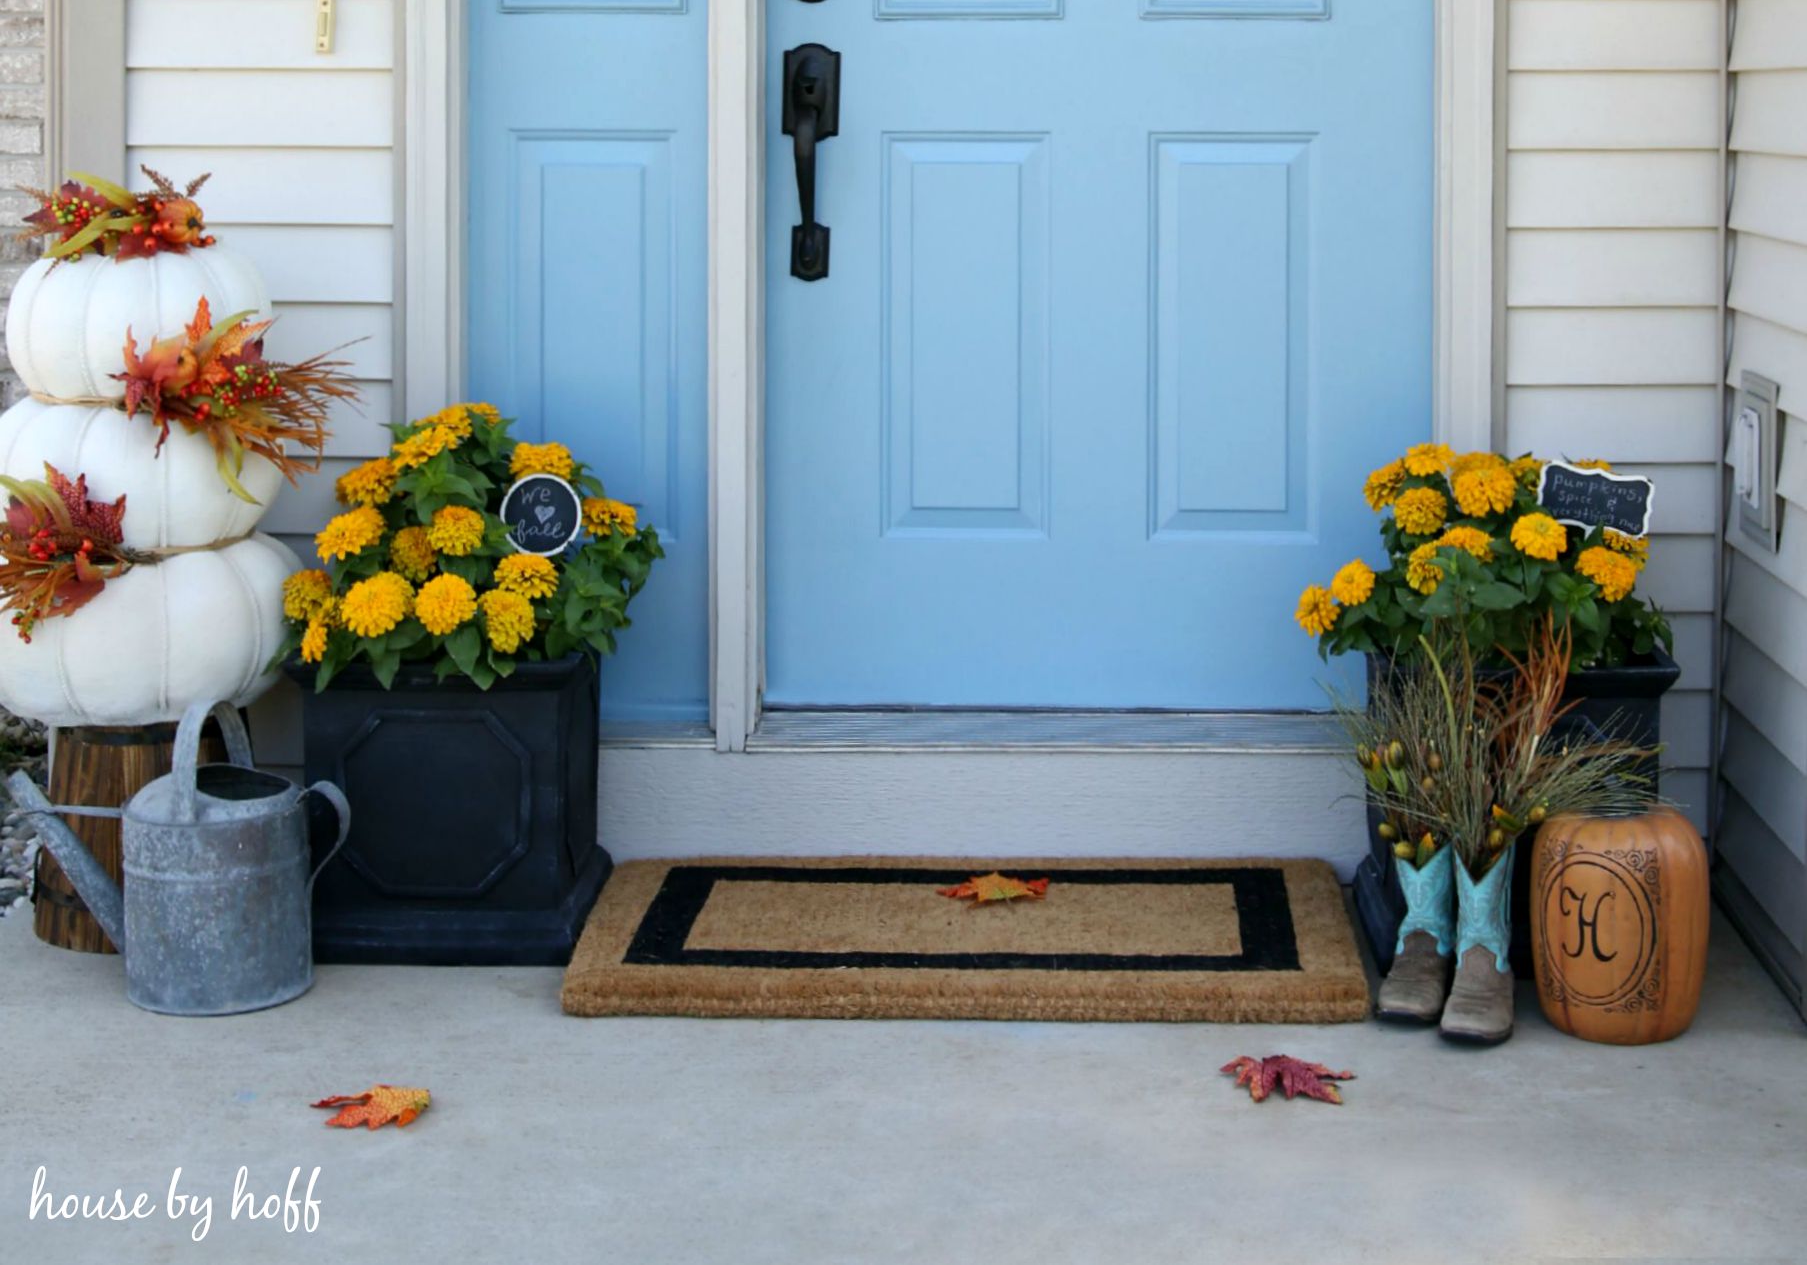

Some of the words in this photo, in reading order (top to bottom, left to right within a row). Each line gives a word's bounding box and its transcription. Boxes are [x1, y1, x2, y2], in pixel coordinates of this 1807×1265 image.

[520, 486, 551, 504] we
[512, 518, 565, 544] fall
[1559, 886, 1618, 962] H
